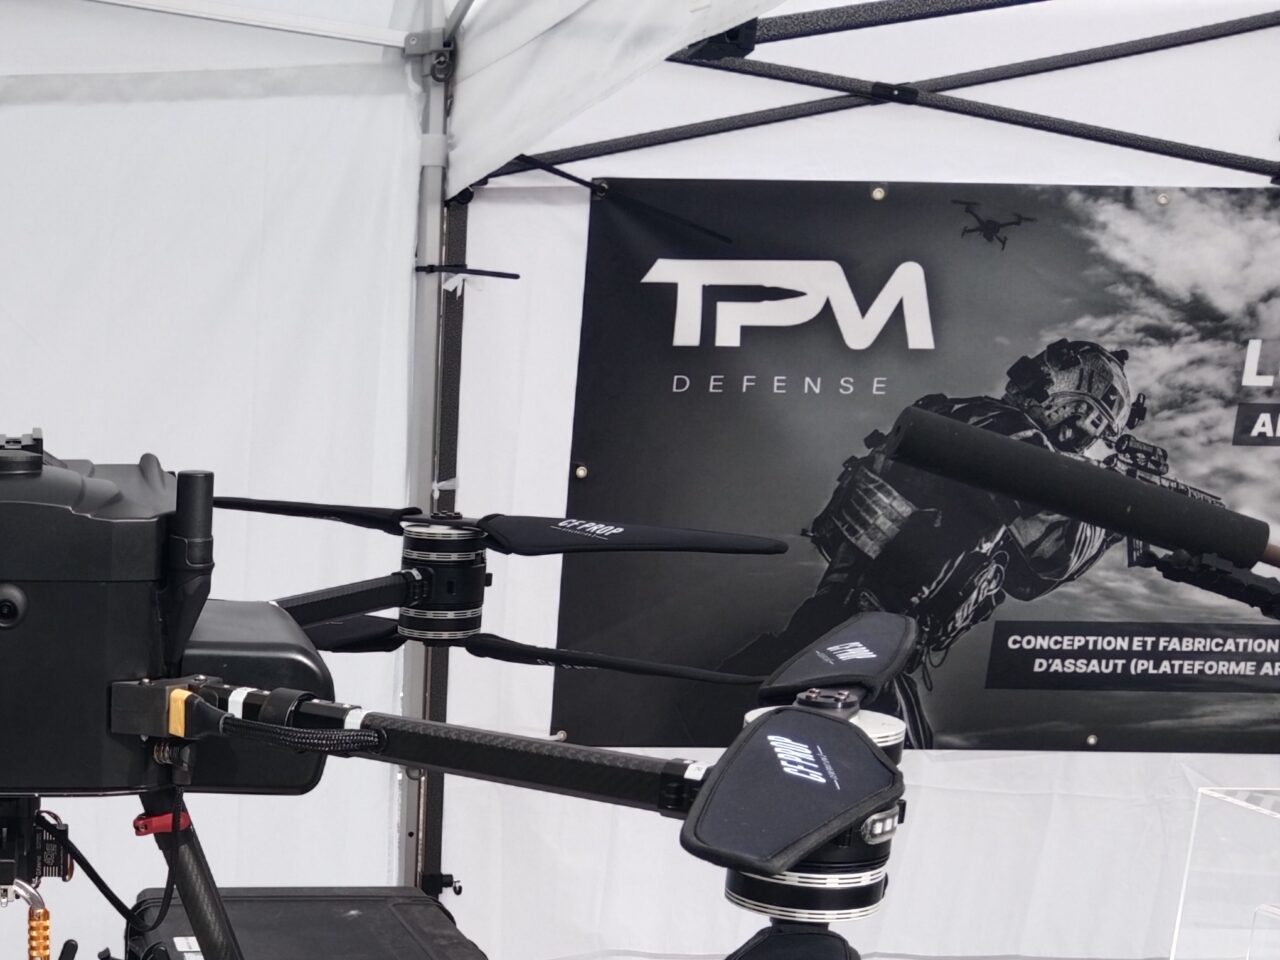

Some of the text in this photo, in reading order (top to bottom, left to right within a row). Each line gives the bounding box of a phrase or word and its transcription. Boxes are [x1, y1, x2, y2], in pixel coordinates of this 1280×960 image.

[640, 257, 935, 350] TPM
[1242, 339, 1280, 387] L
[672, 374, 888, 395] DEFENSE
[1250, 412, 1280, 437] A
[1007, 635, 1280, 653] CONCEPTION ET FABRICATION
[1130, 658, 1256, 676] (PLATEFORME
